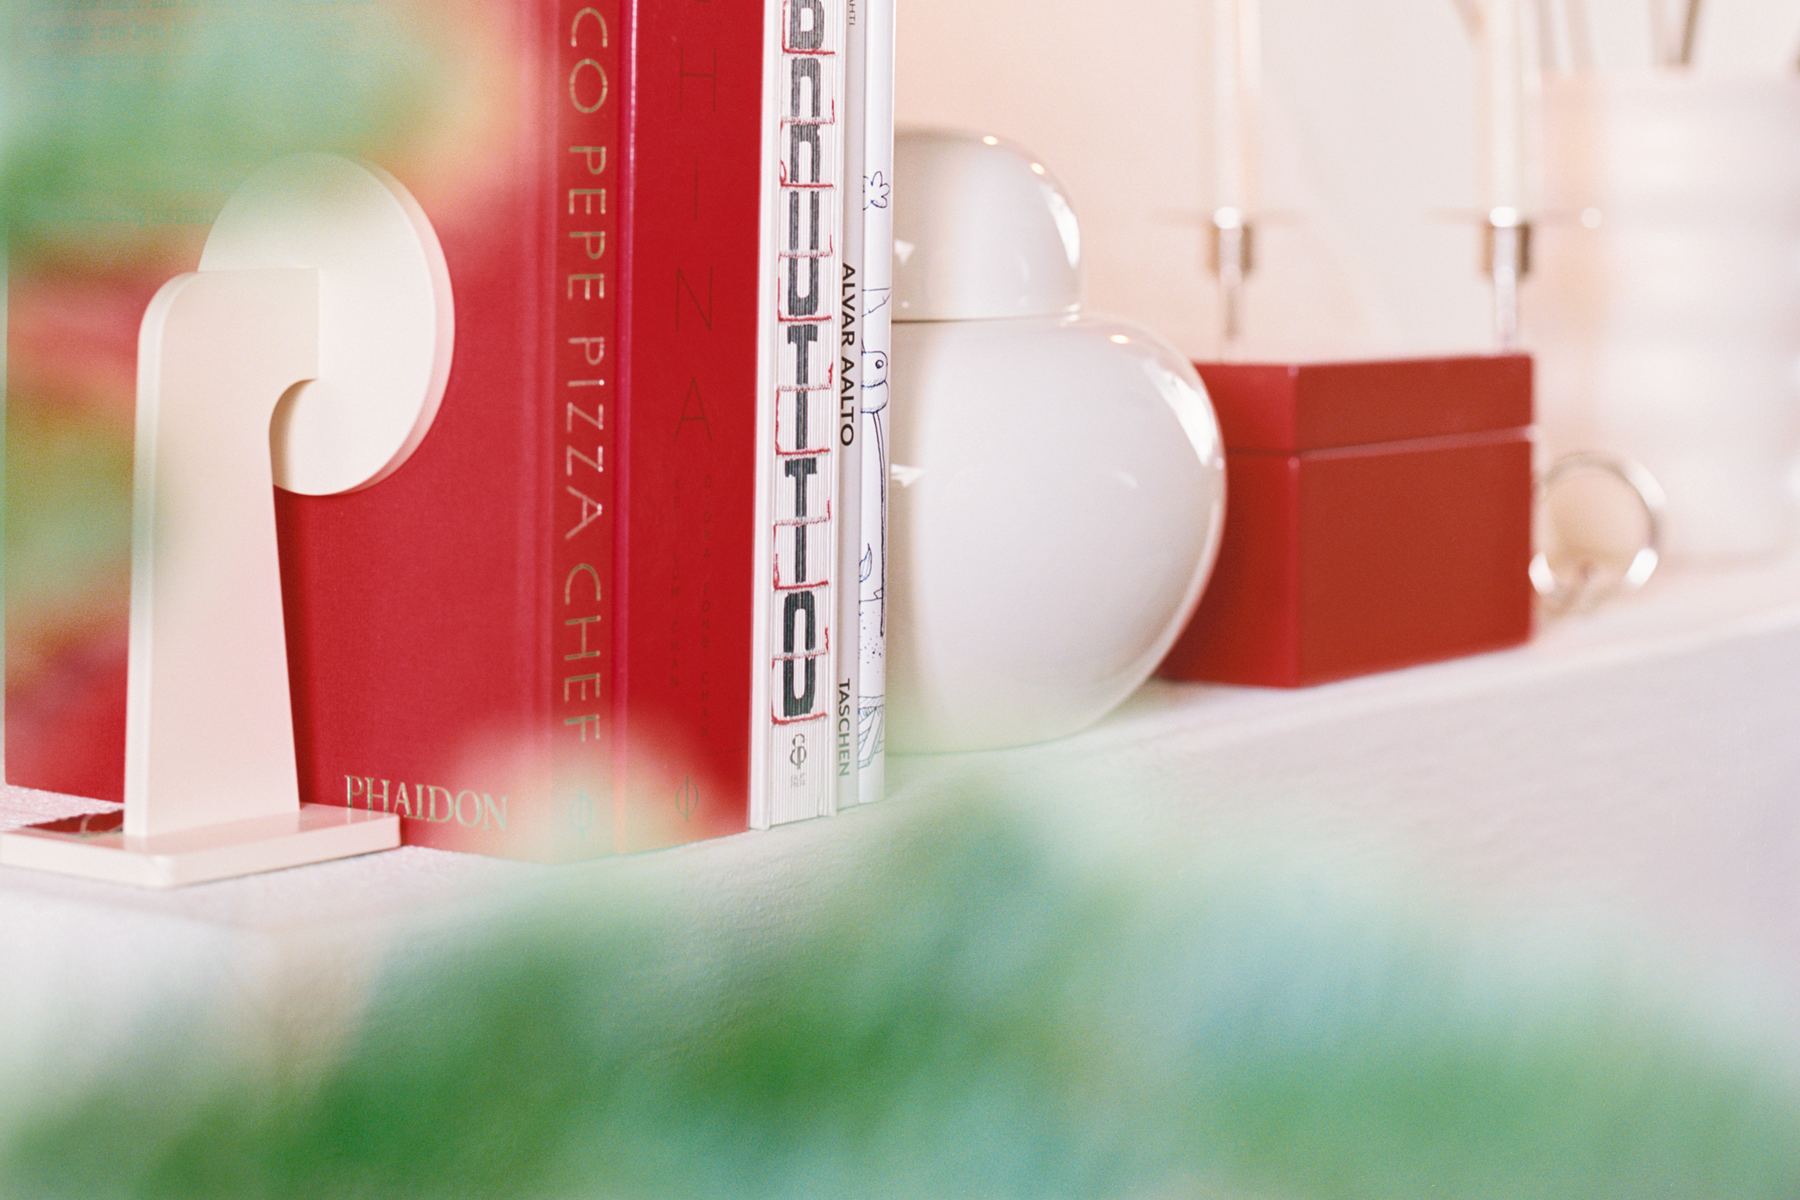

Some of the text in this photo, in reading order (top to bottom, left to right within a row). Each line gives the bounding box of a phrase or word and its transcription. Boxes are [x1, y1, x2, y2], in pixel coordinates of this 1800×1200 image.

[567, 145, 607, 300] PEPE
[565, 336, 605, 540] PIZZA
[840, 262, 856, 447] ALVAR AALTO
[564, 563, 602, 742] CHEF
[838, 678, 850, 777] TASCHEN
[344, 774, 509, 831] PHAIDON
